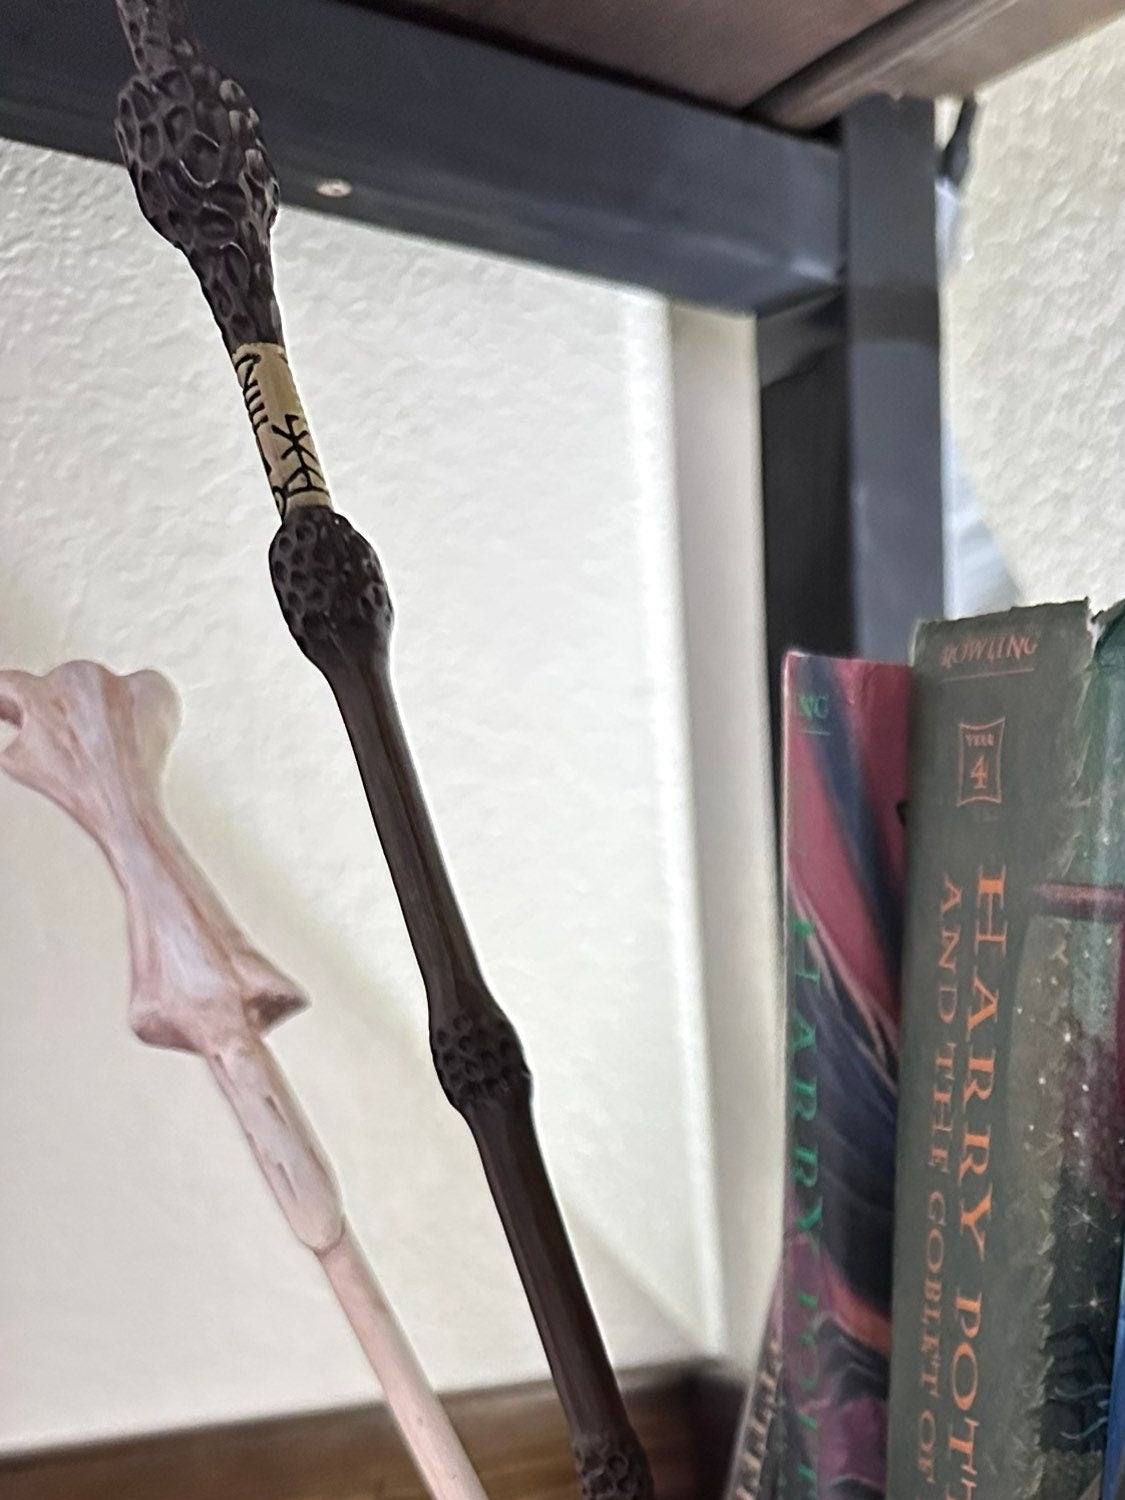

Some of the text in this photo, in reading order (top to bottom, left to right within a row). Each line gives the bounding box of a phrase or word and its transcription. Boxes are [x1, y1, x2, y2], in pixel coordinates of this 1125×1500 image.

[940, 635, 1039, 669] ROWLING
[969, 753, 990, 790] 4
[936, 873, 964, 1024] AND
[793, 912, 824, 1256] HARRY
[926, 1043, 956, 1175] THE
[958, 864, 1009, 1263] HARRY
[918, 1190, 946, 1400] GOBLET
[914, 1409, 937, 1484] OF
